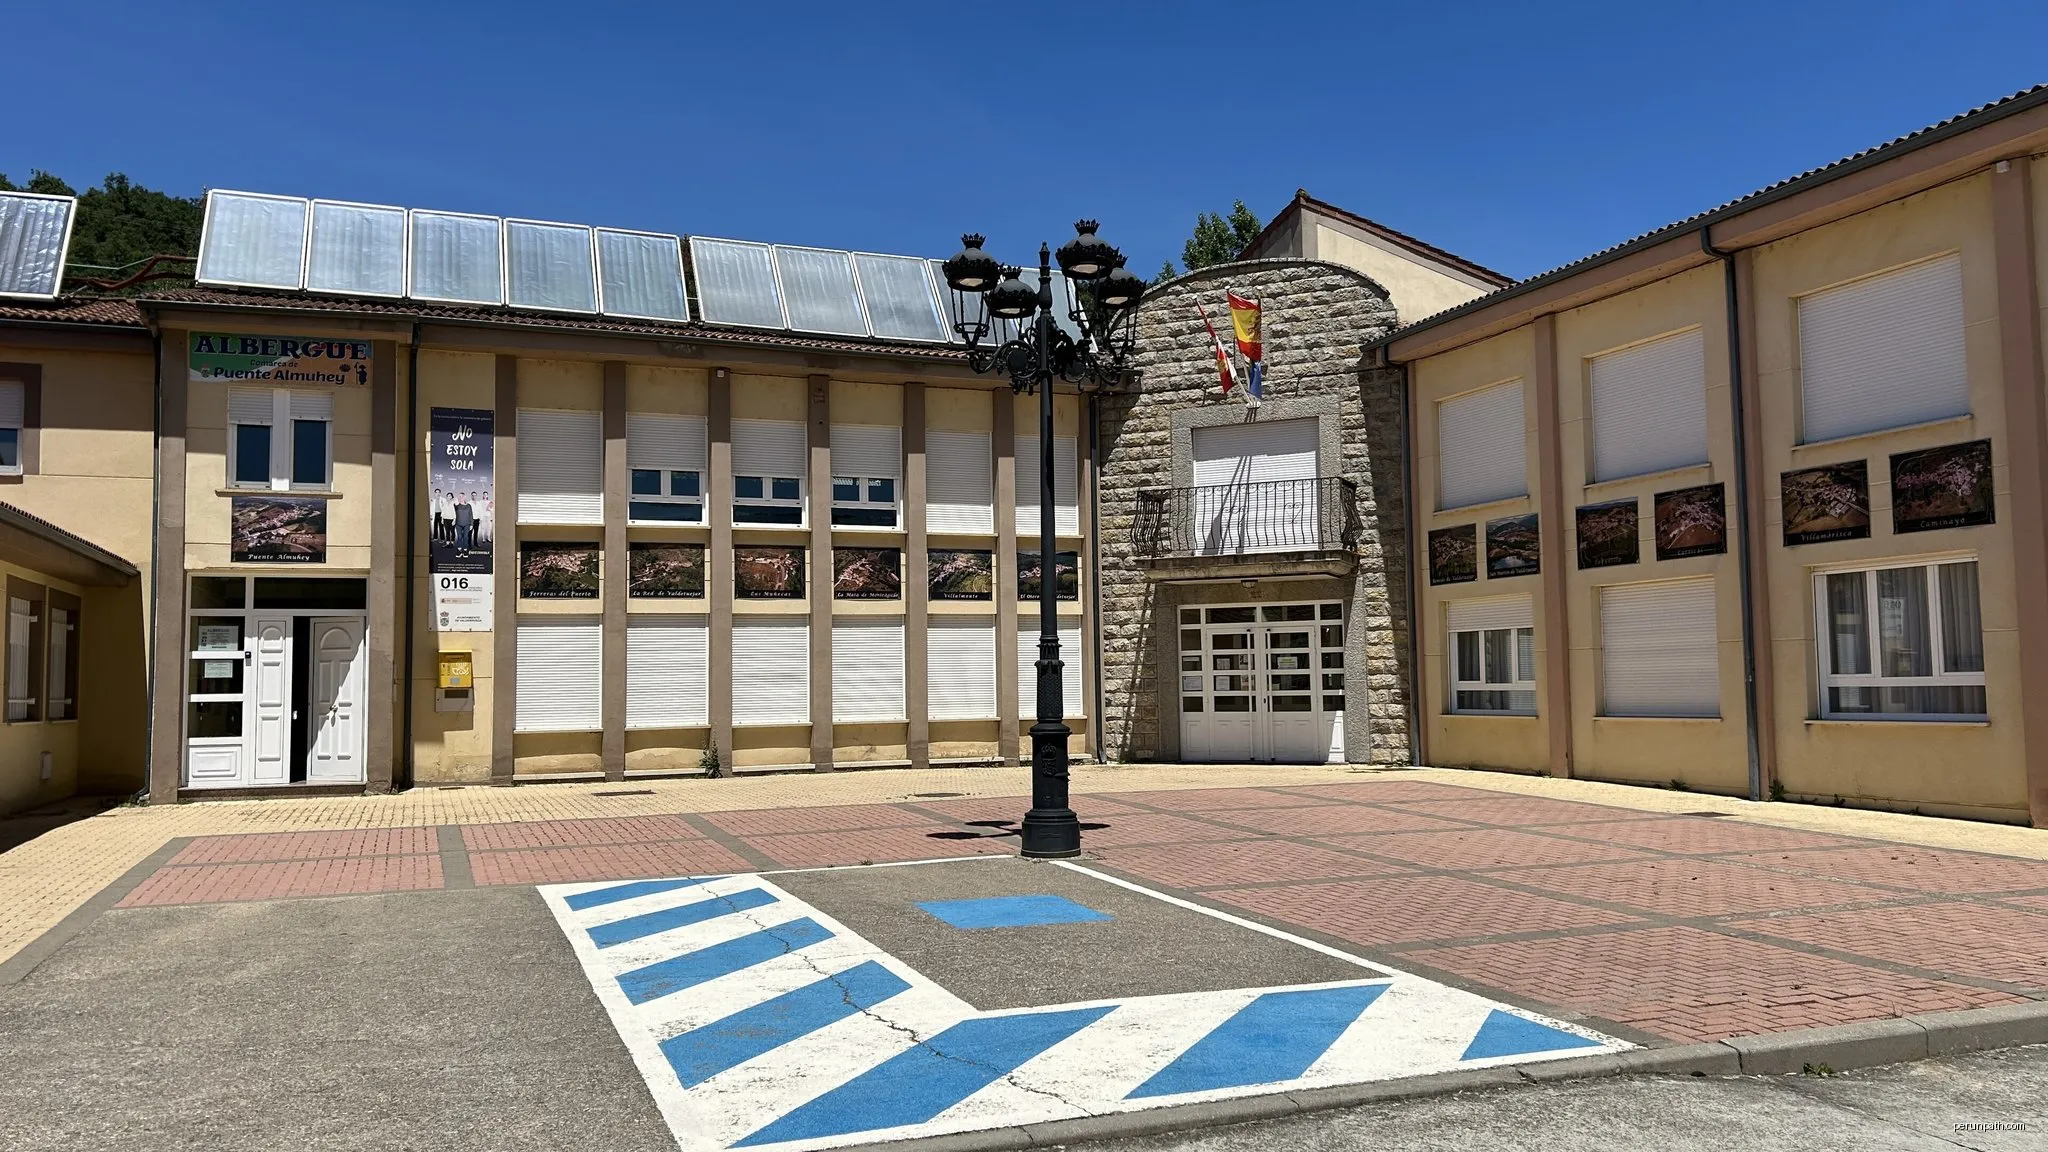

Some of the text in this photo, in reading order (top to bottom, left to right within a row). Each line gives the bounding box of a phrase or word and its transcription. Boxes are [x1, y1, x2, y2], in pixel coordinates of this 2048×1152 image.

[194, 336, 367, 360] ALBERGUE
[250, 359, 287, 367] Comarca
[214, 367, 345, 385] Puente Almuhey
[451, 425, 473, 441] No
[446, 444, 478, 457] ESTOY
[450, 459, 474, 471] SOLA
[1920, 517, 1965, 528] Caminayo
[277, 553, 310, 561] Almuhey
[440, 577, 469, 589] 016
[529, 590, 557, 598] Ferreras
